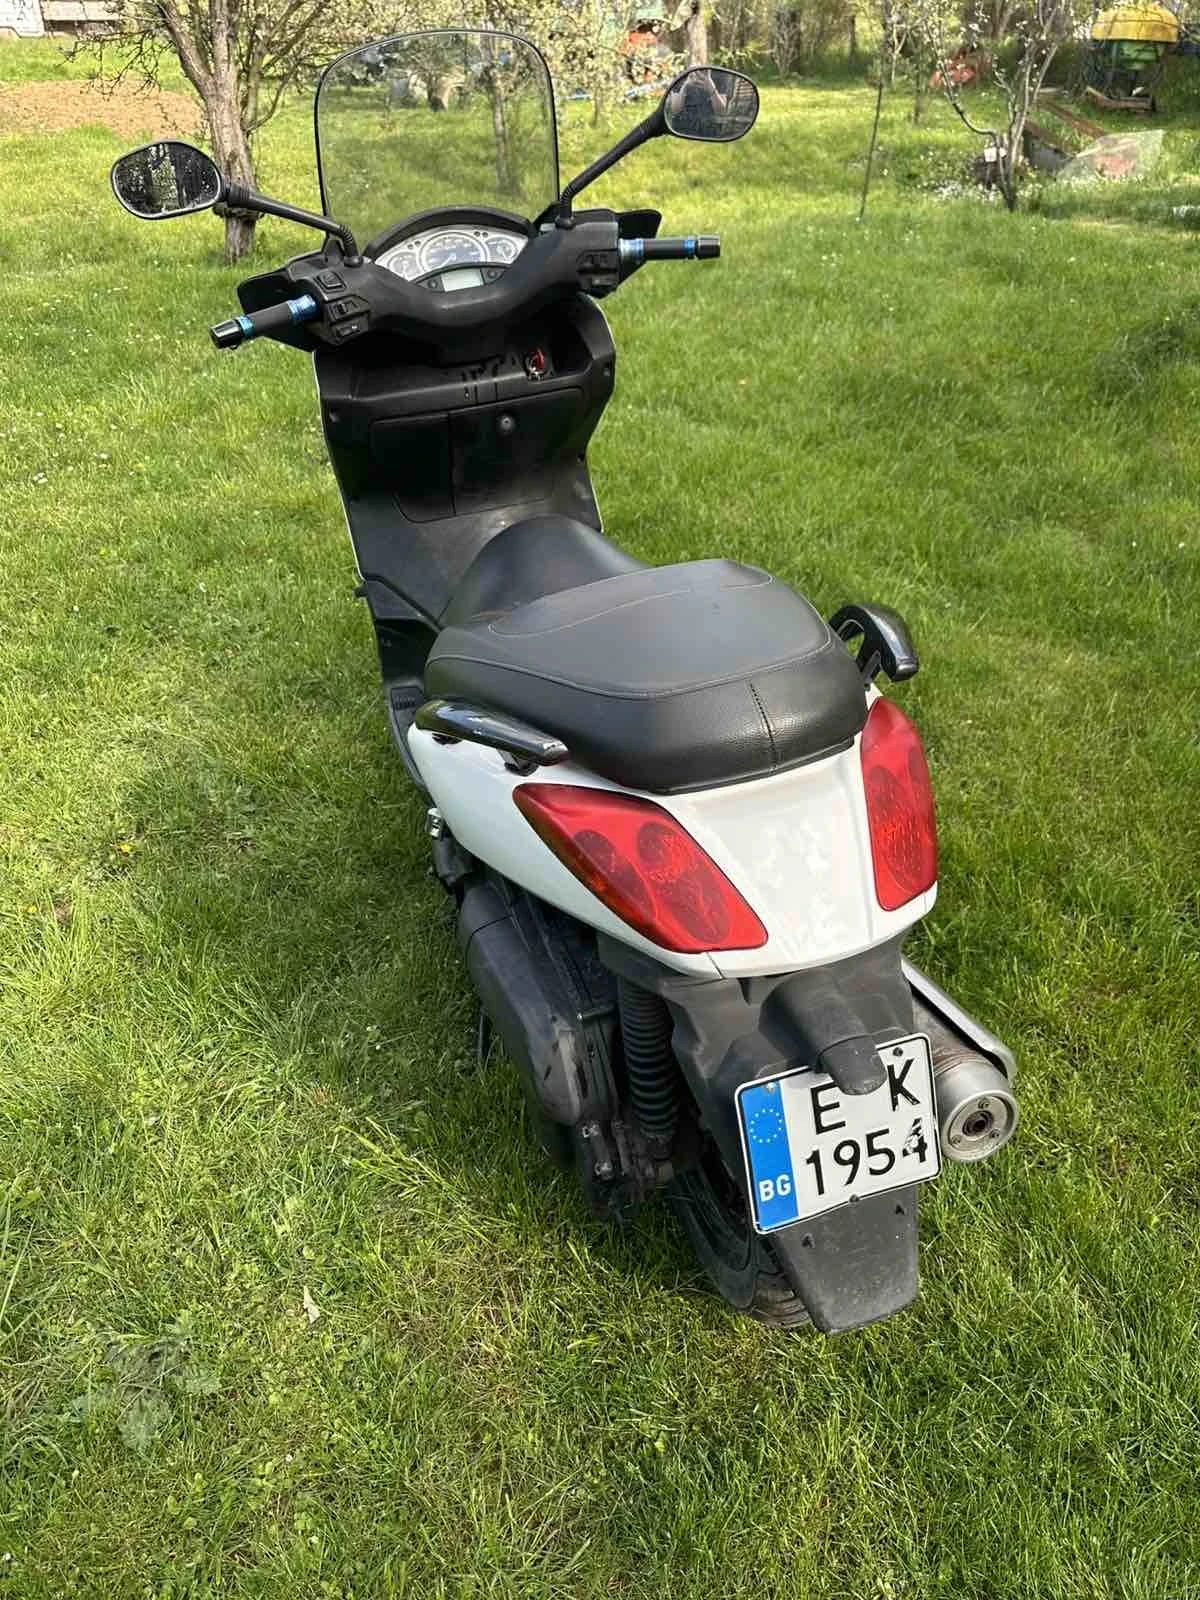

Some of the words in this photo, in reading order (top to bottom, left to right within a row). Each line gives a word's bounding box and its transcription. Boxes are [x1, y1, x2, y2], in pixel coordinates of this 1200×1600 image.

[810, 1081, 846, 1135] E
[887, 1058, 921, 1112] K
[759, 1174, 792, 1202] BG
[806, 1117, 928, 1196] 1954
